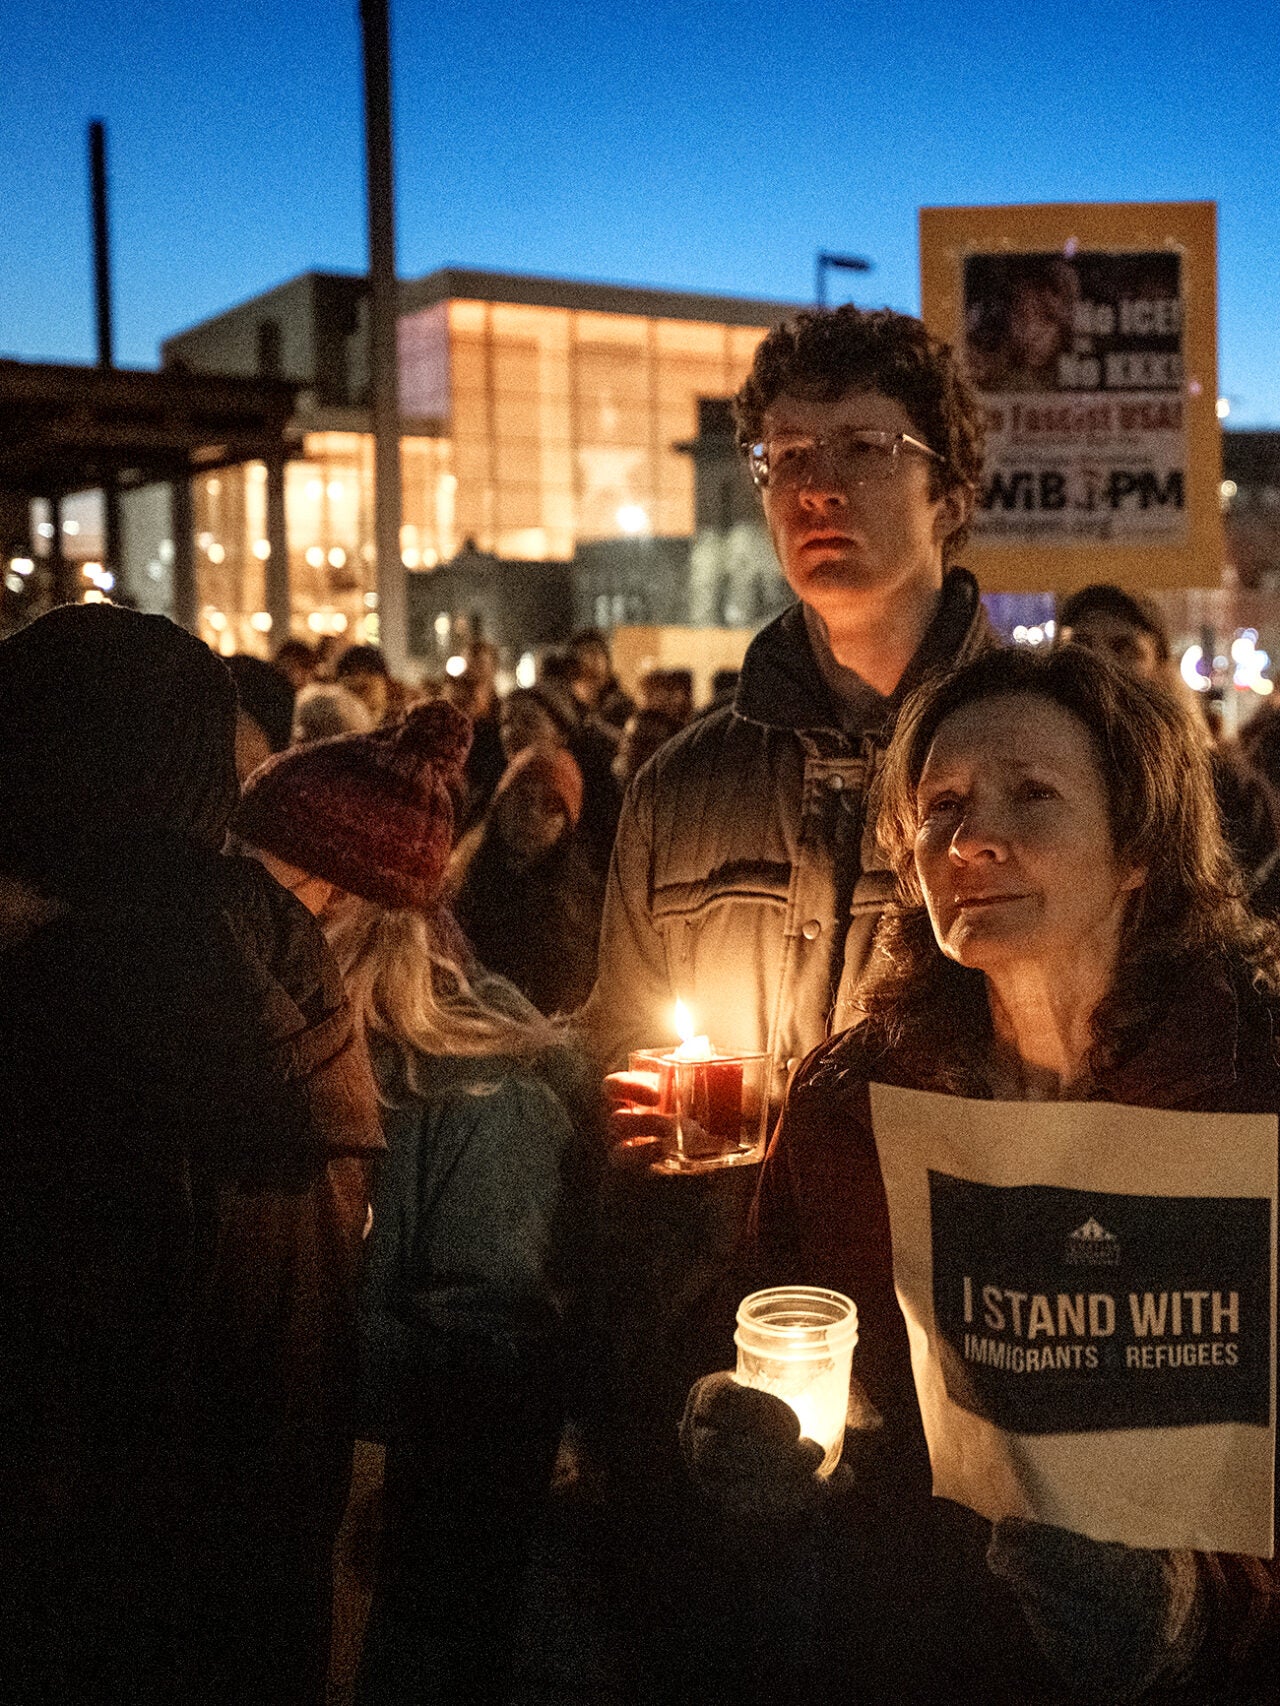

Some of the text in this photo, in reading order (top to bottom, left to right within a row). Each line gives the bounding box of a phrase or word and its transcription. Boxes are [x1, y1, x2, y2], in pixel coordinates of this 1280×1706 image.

[963, 1276, 1240, 1340] I STAND WITH
[964, 1334, 1099, 1374] IMMIGRANTS
[1126, 1342, 1239, 1369] REFUGEES
